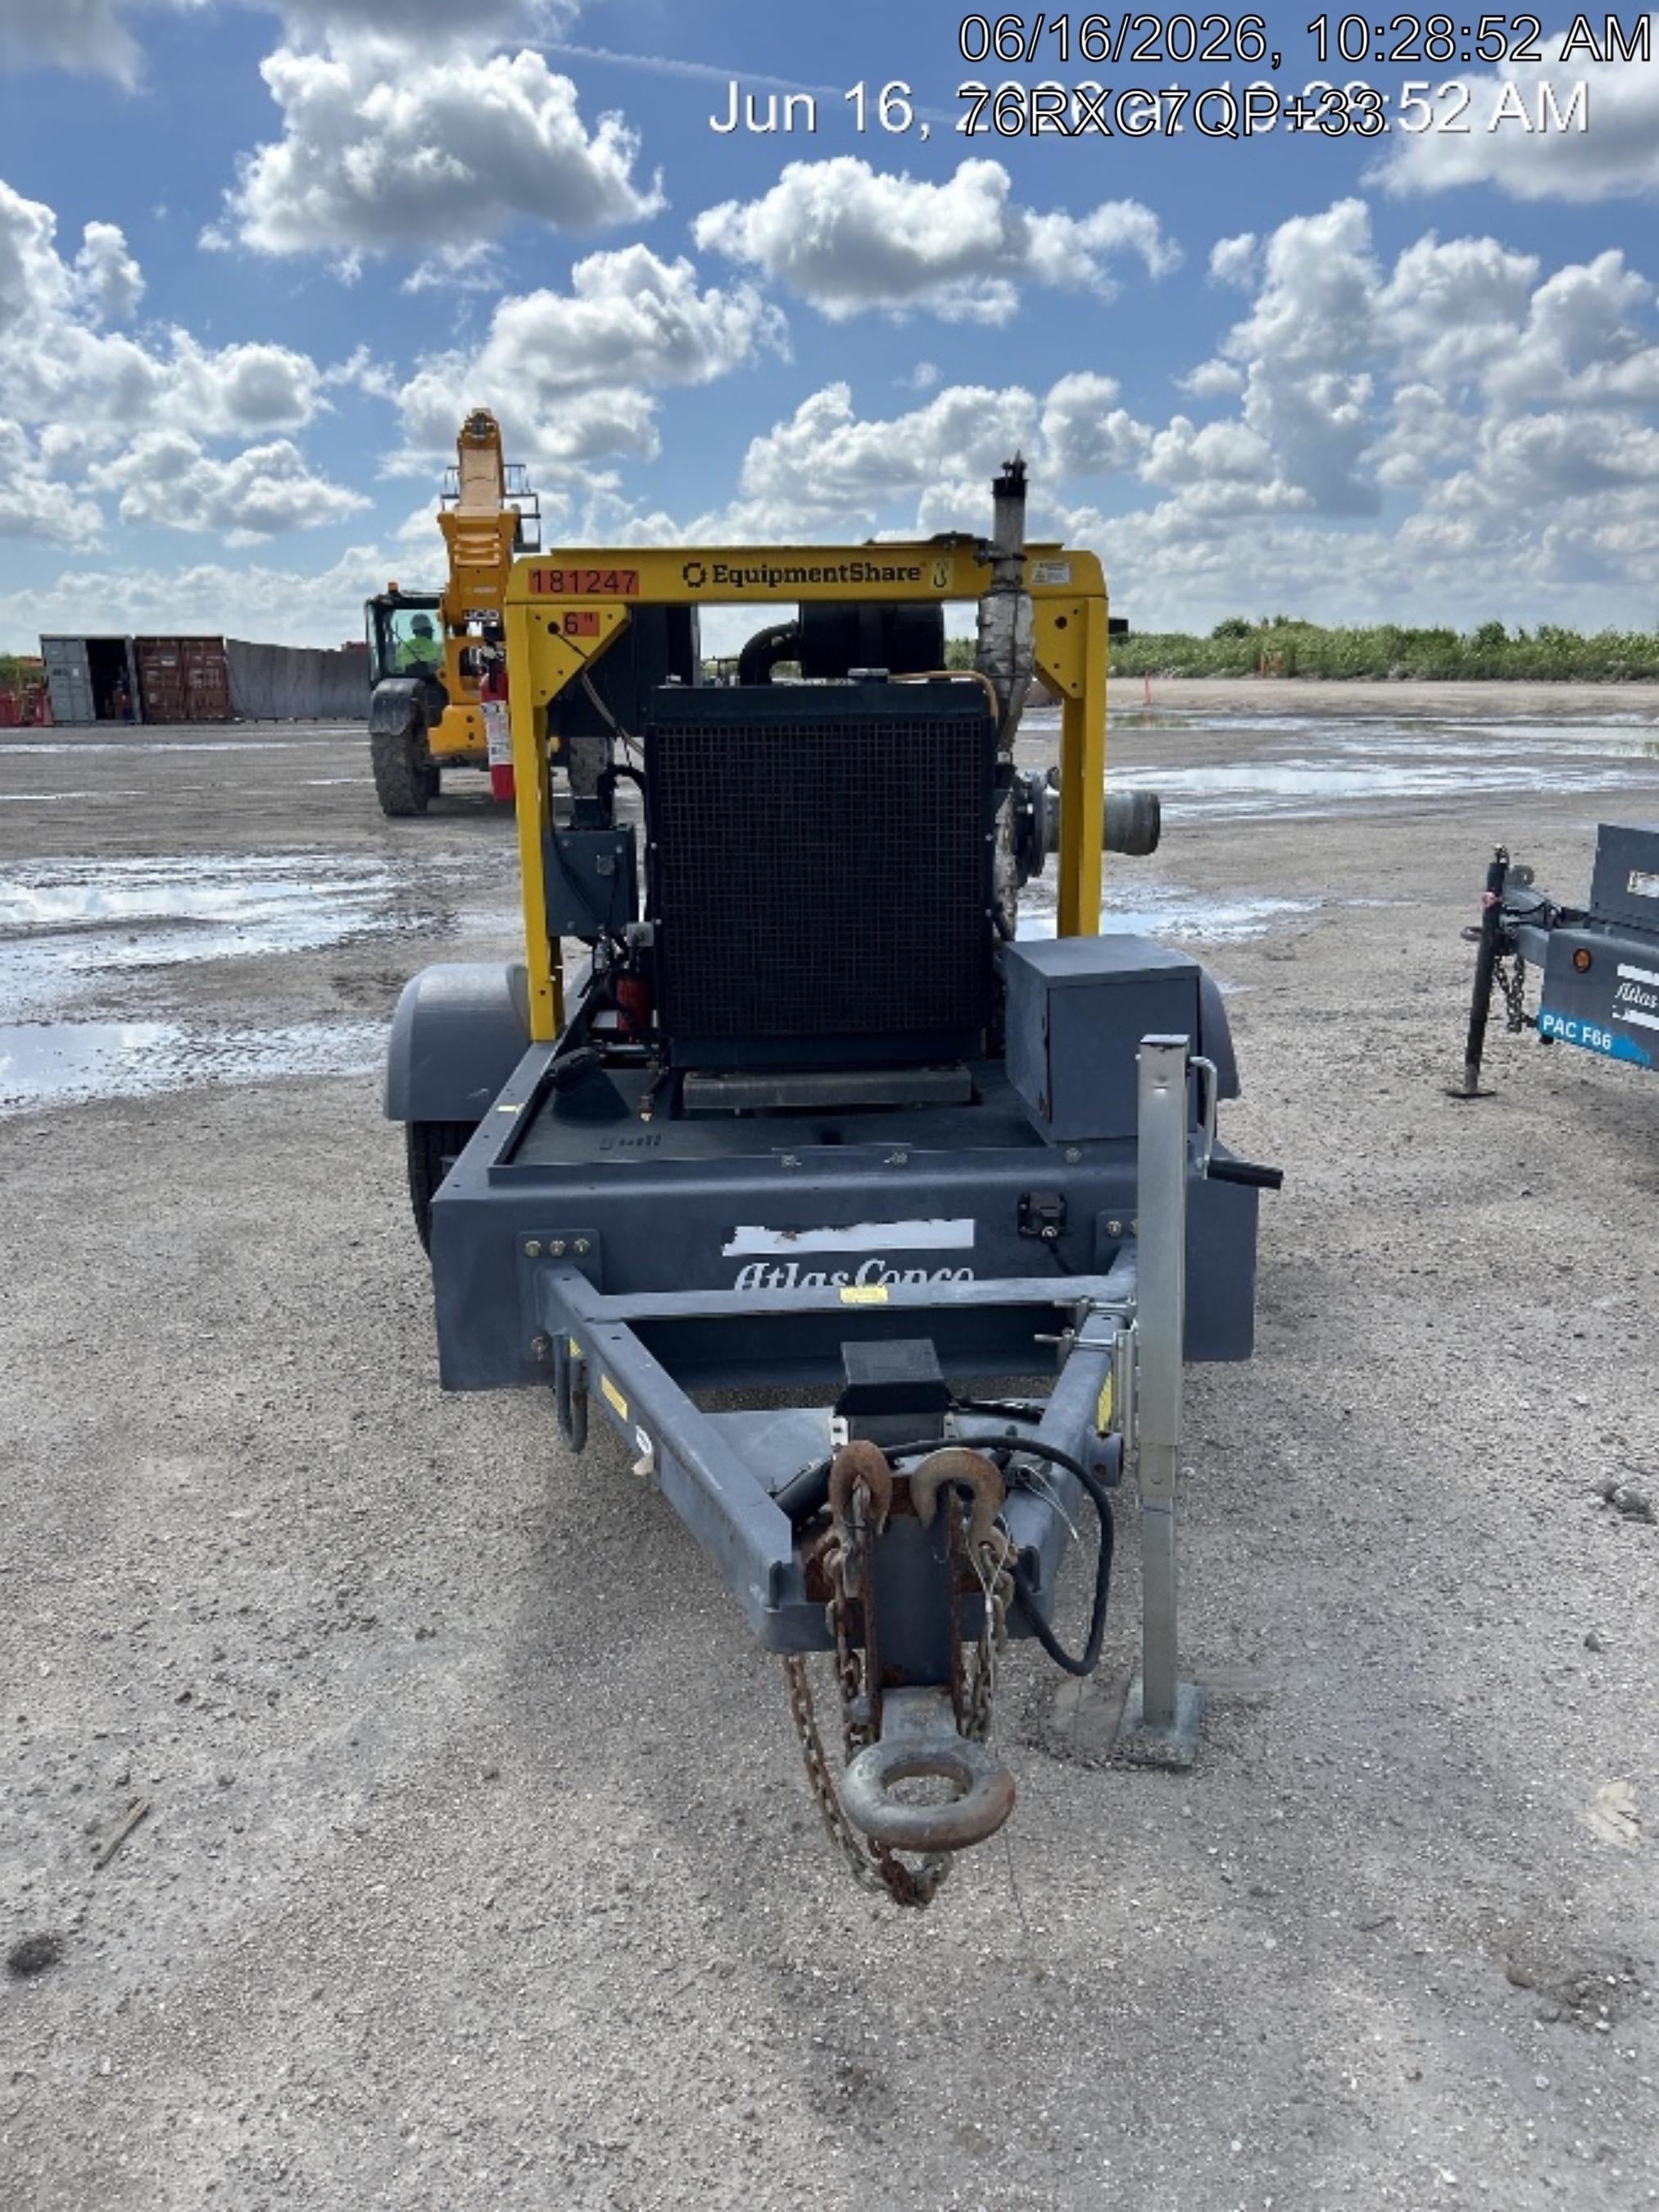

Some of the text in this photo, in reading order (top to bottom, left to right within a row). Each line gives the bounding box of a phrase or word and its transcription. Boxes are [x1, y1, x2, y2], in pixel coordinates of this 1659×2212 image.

[533, 569, 637, 594] 181247
[711, 563, 922, 588] EquipmentShare
[1543, 1014, 1612, 1050] PAC F66
[734, 1262, 850, 1291] Atlas
